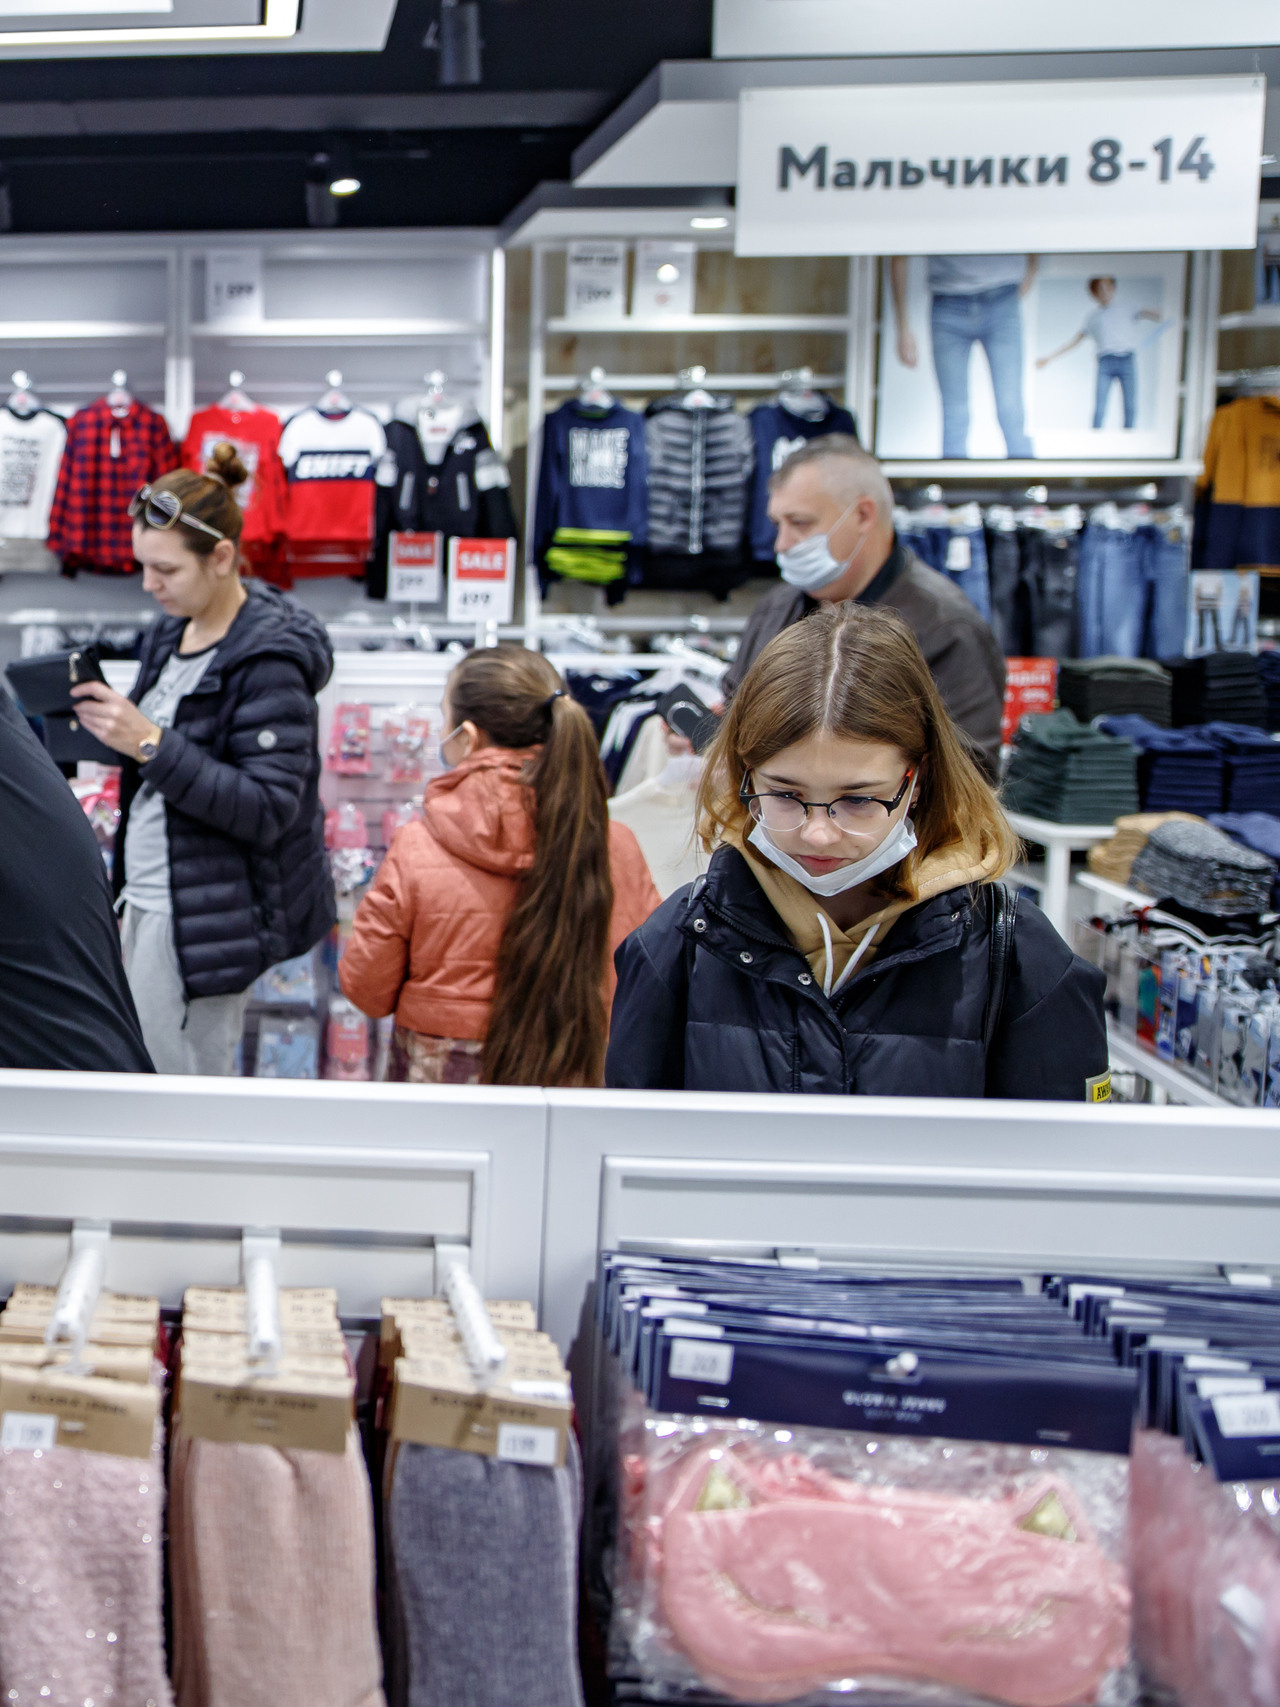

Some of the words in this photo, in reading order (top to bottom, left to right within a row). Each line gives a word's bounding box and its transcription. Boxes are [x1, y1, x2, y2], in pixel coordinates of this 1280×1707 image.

[777, 144, 1069, 191] Мальчики
[1086, 136, 1215, 185] 8-14
[459, 551, 506, 571] SALE
